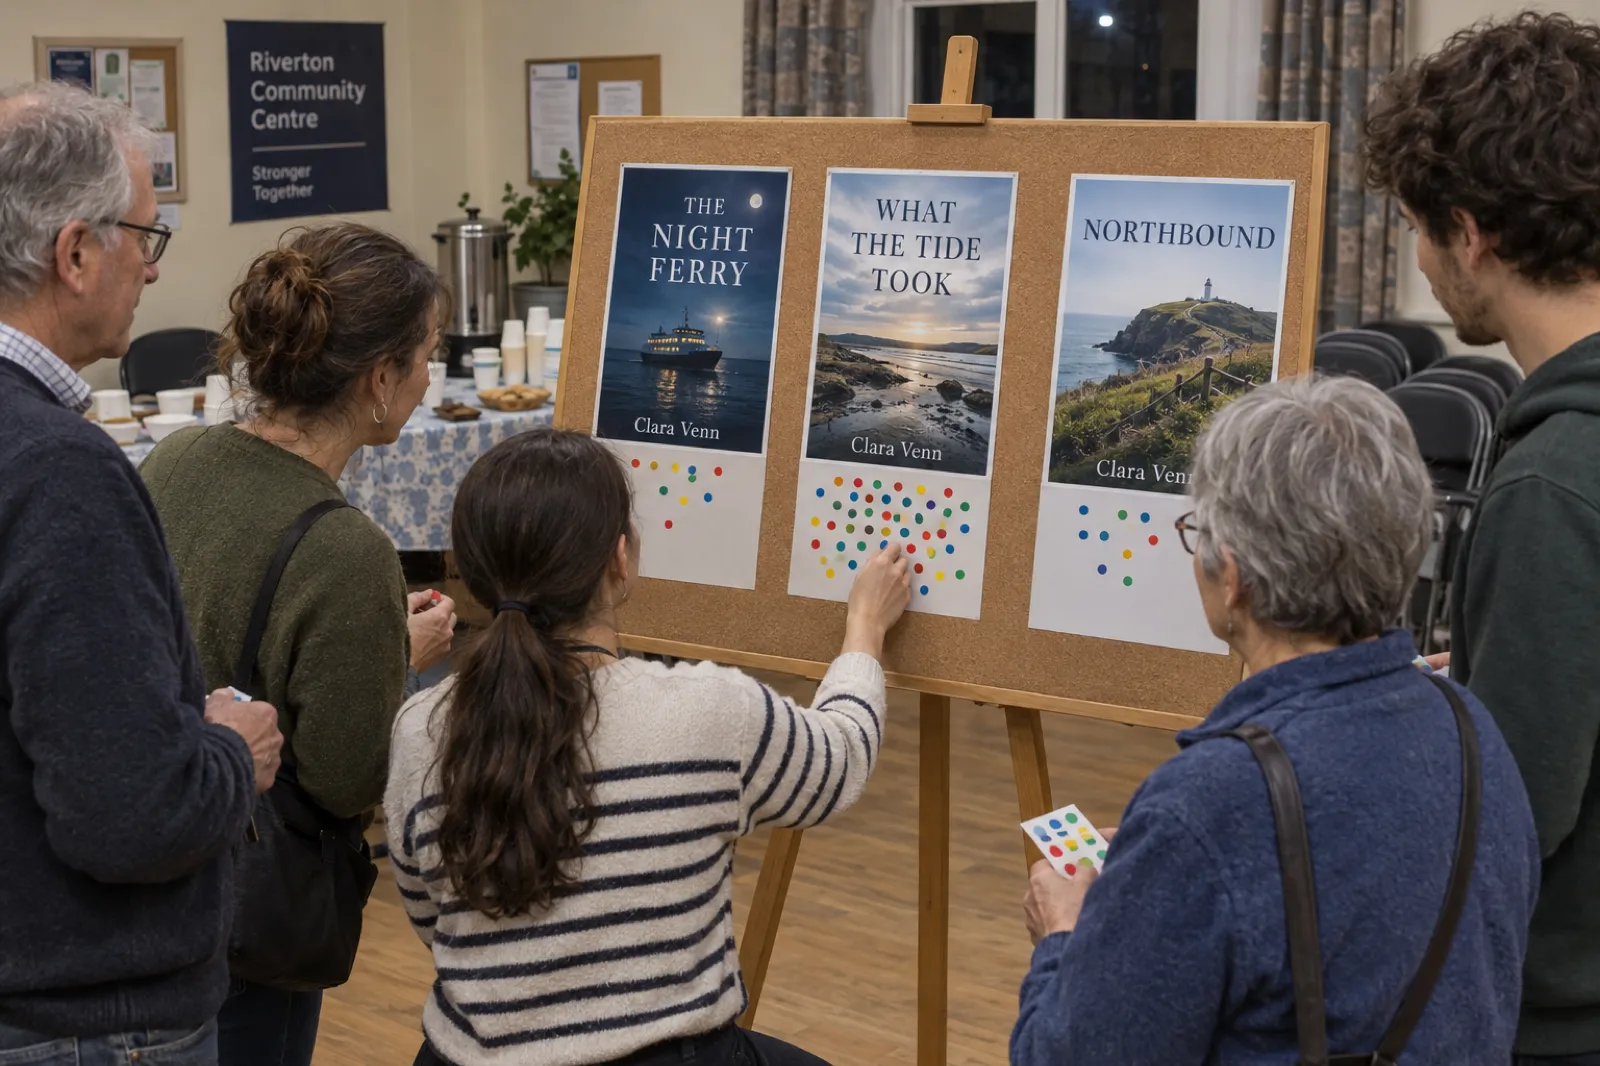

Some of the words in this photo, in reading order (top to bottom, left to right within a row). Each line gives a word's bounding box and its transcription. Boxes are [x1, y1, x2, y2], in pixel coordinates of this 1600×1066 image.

[250, 51, 335, 73] Riverton
[250, 80, 367, 106] Community
[250, 108, 319, 130] Centre
[252, 165, 312, 182] Stronger
[252, 184, 313, 204] Together
[683, 196, 726, 216] THE
[875, 198, 957, 225] WHAT
[651, 223, 754, 253] NIGHT
[1082, 217, 1277, 251] NORTHBOUND
[851, 232, 906, 258] THE
[915, 234, 982, 262] TIDE
[648, 256, 750, 287] FERRY
[871, 267, 953, 297] TOOK
[633, 416, 675, 436] Clara
[680, 420, 720, 440] Venn
[851, 436, 895, 457] Clara
[900, 440, 943, 461] Venn
[1096, 459, 1146, 481] Clara
